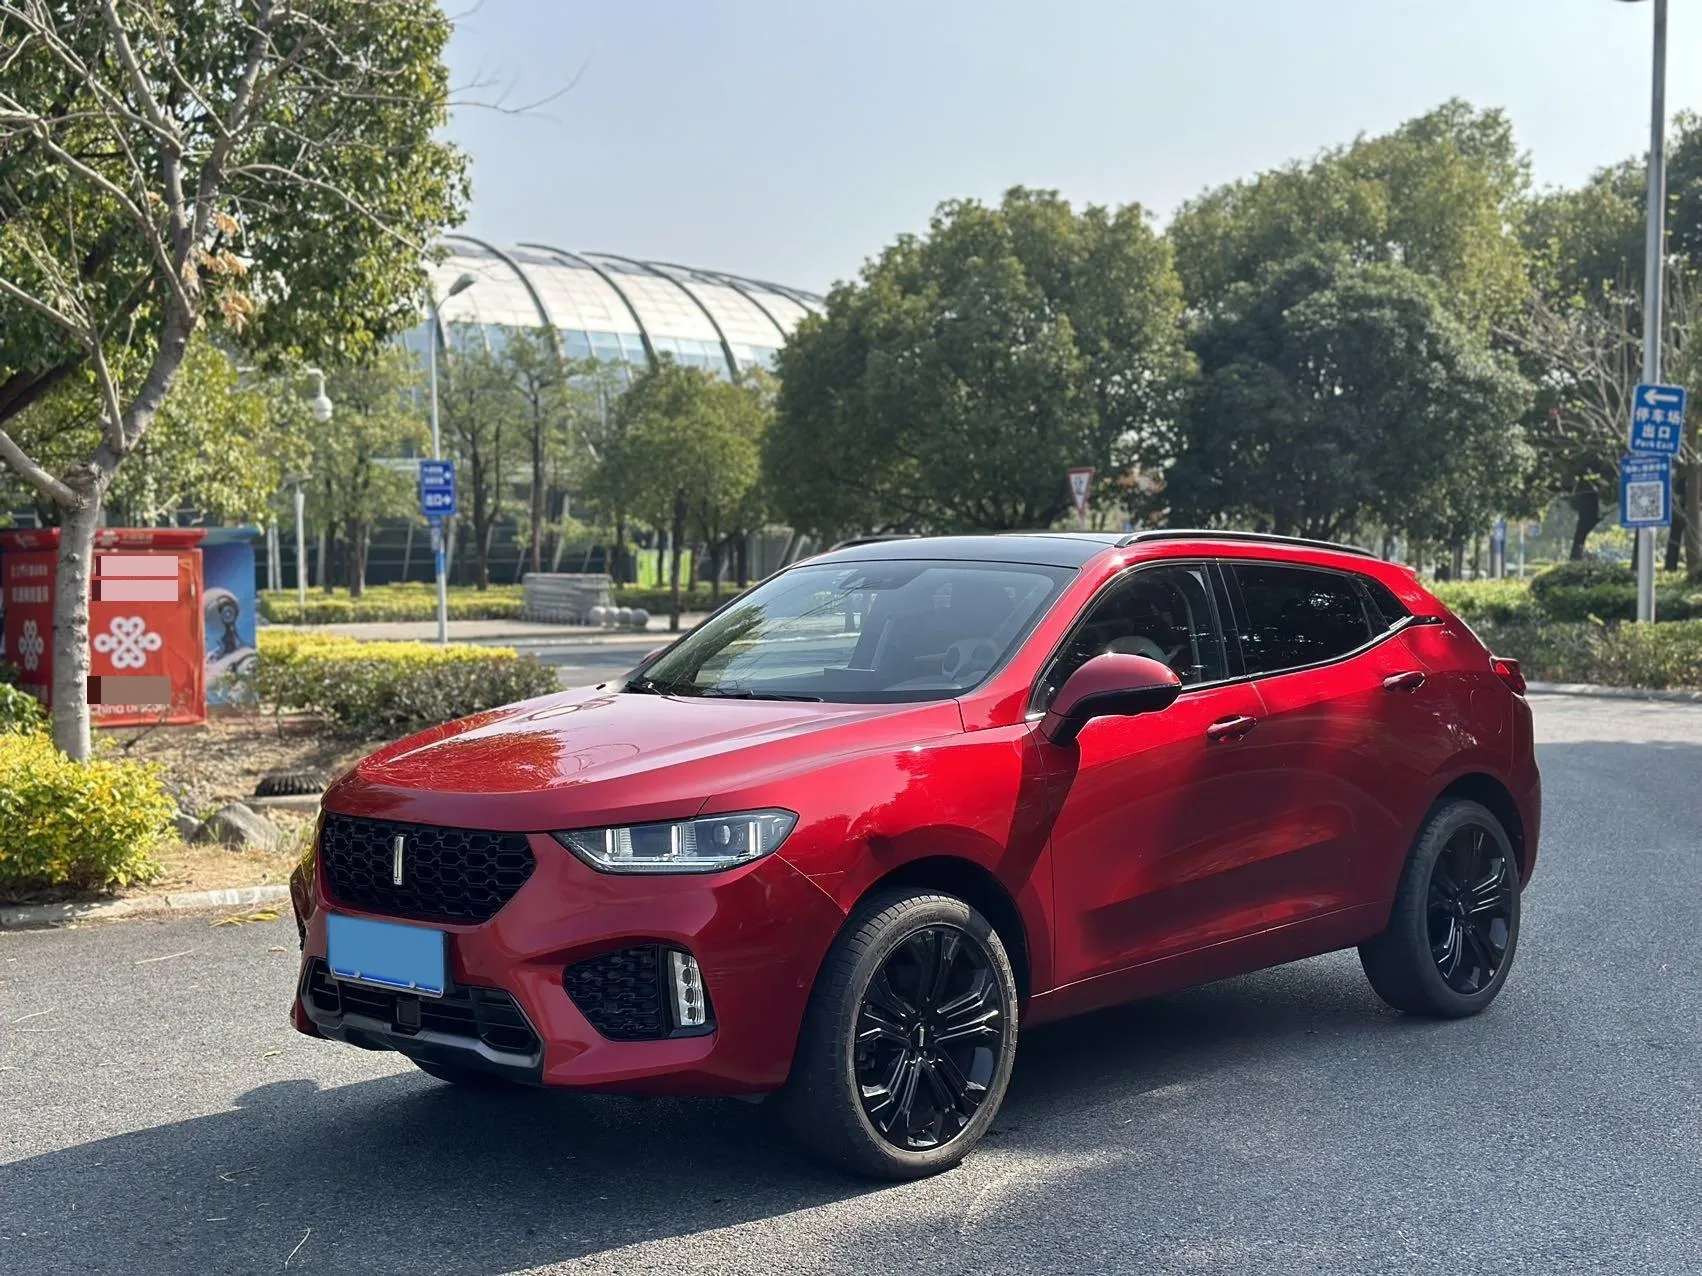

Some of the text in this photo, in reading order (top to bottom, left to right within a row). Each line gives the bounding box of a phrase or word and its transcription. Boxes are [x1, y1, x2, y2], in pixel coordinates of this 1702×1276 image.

[1635, 407, 1681, 425] 停车场
[1642, 423, 1671, 440] 出口
